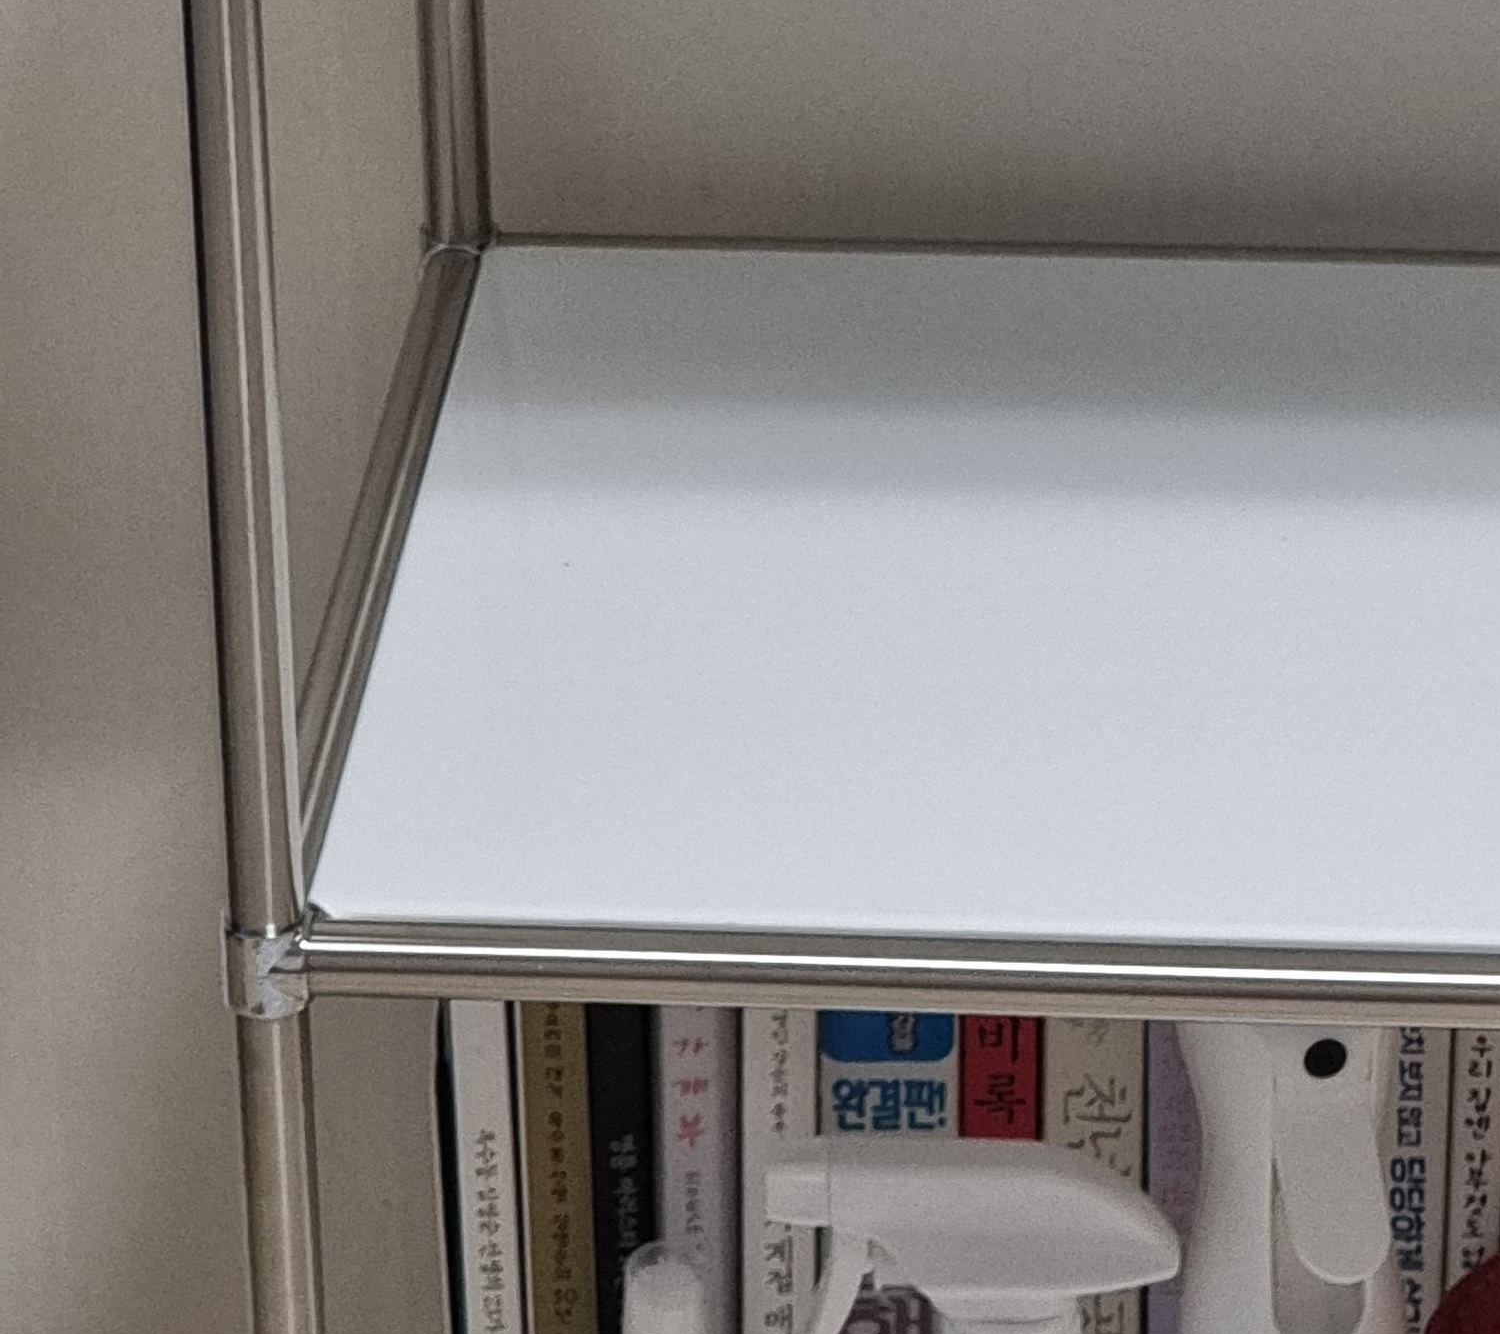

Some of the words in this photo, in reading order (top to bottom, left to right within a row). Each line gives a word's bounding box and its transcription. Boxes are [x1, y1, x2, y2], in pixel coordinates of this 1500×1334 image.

[1469, 1034, 1496, 1078] 우리
[1399, 1060, 1424, 1101] 보지
[1388, 1158, 1425, 1272] 당당하게
